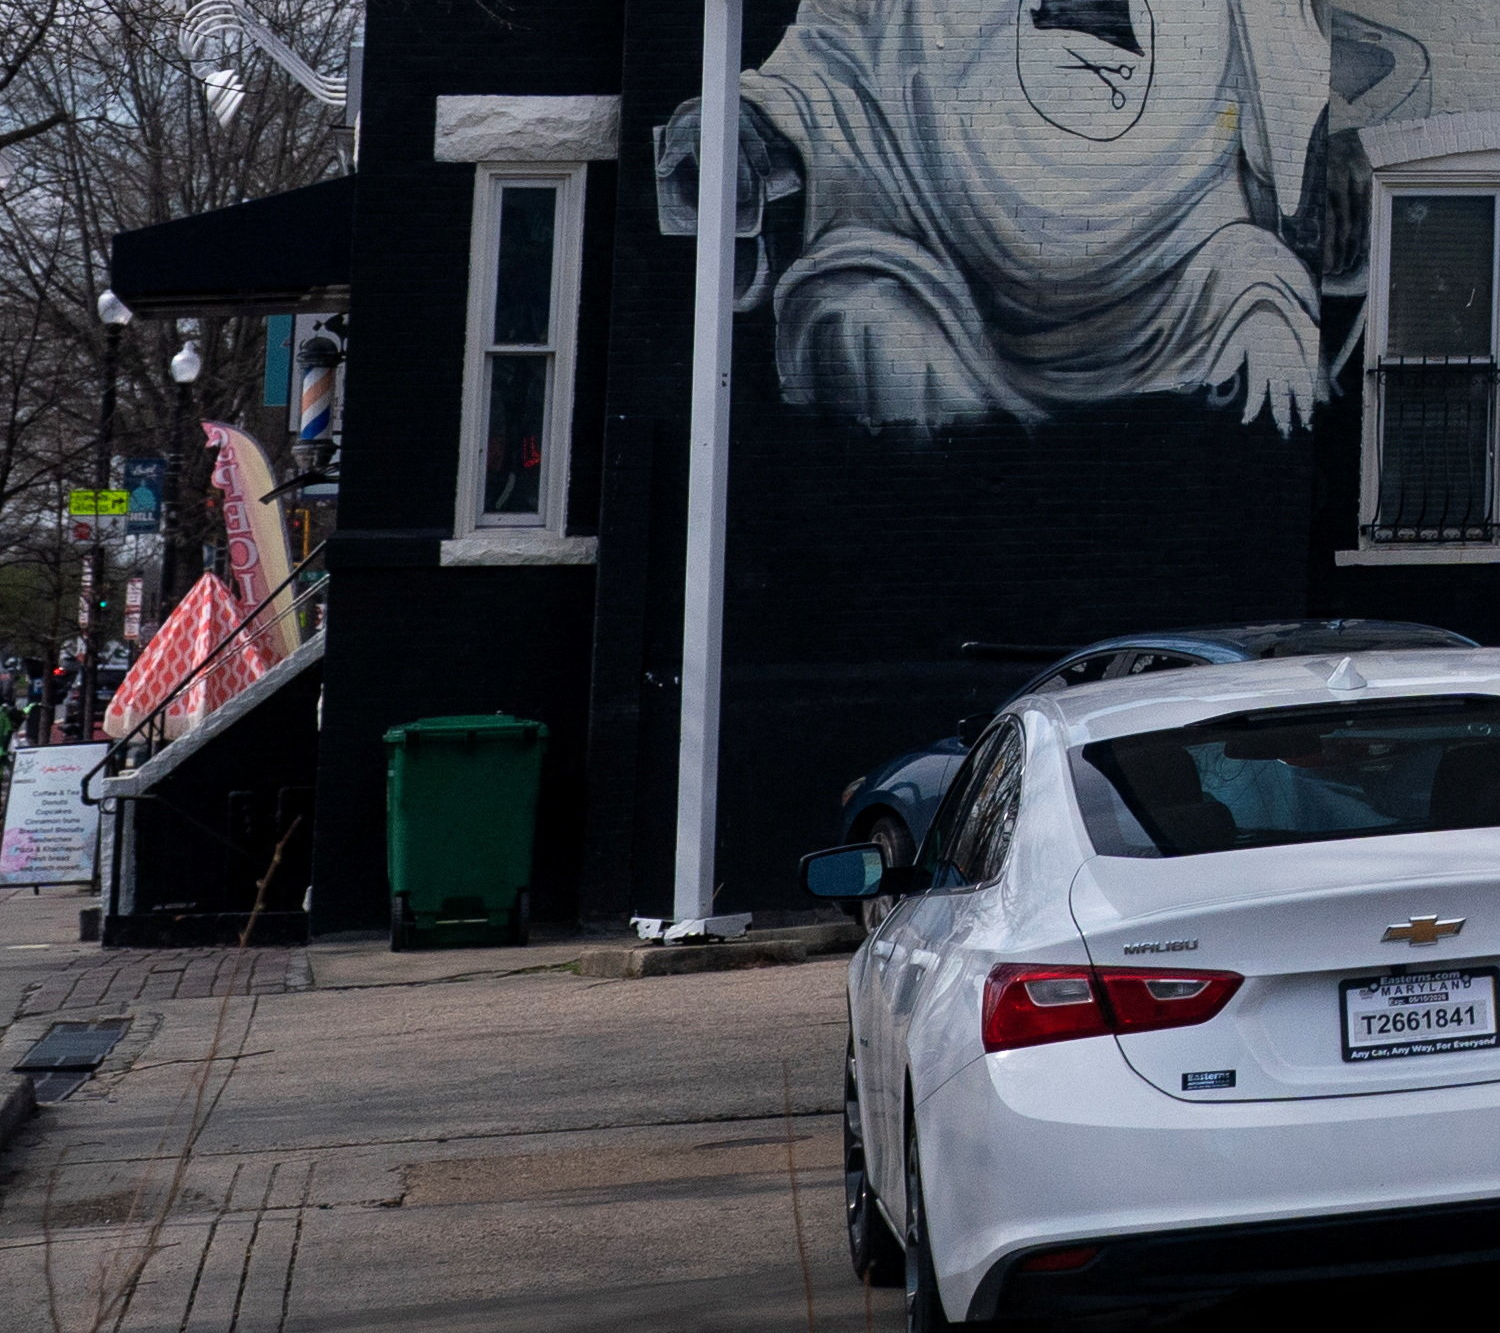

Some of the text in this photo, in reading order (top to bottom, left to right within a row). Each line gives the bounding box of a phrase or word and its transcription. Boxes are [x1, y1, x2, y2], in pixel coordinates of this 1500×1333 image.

[1123, 938, 1199, 956] MALIBU
[1380, 971, 1460, 985] Easterns.com
[1380, 979, 1472, 997] MARYLAND
[1361, 1005, 1476, 1035] T2661841
[1351, 1050, 1370, 1059] Any
[1371, 1048, 1390, 1058] Car,
[1391, 1046, 1410, 1055] Any
[1411, 1043, 1435, 1053] Way,
[1436, 1042, 1451, 1050] For
